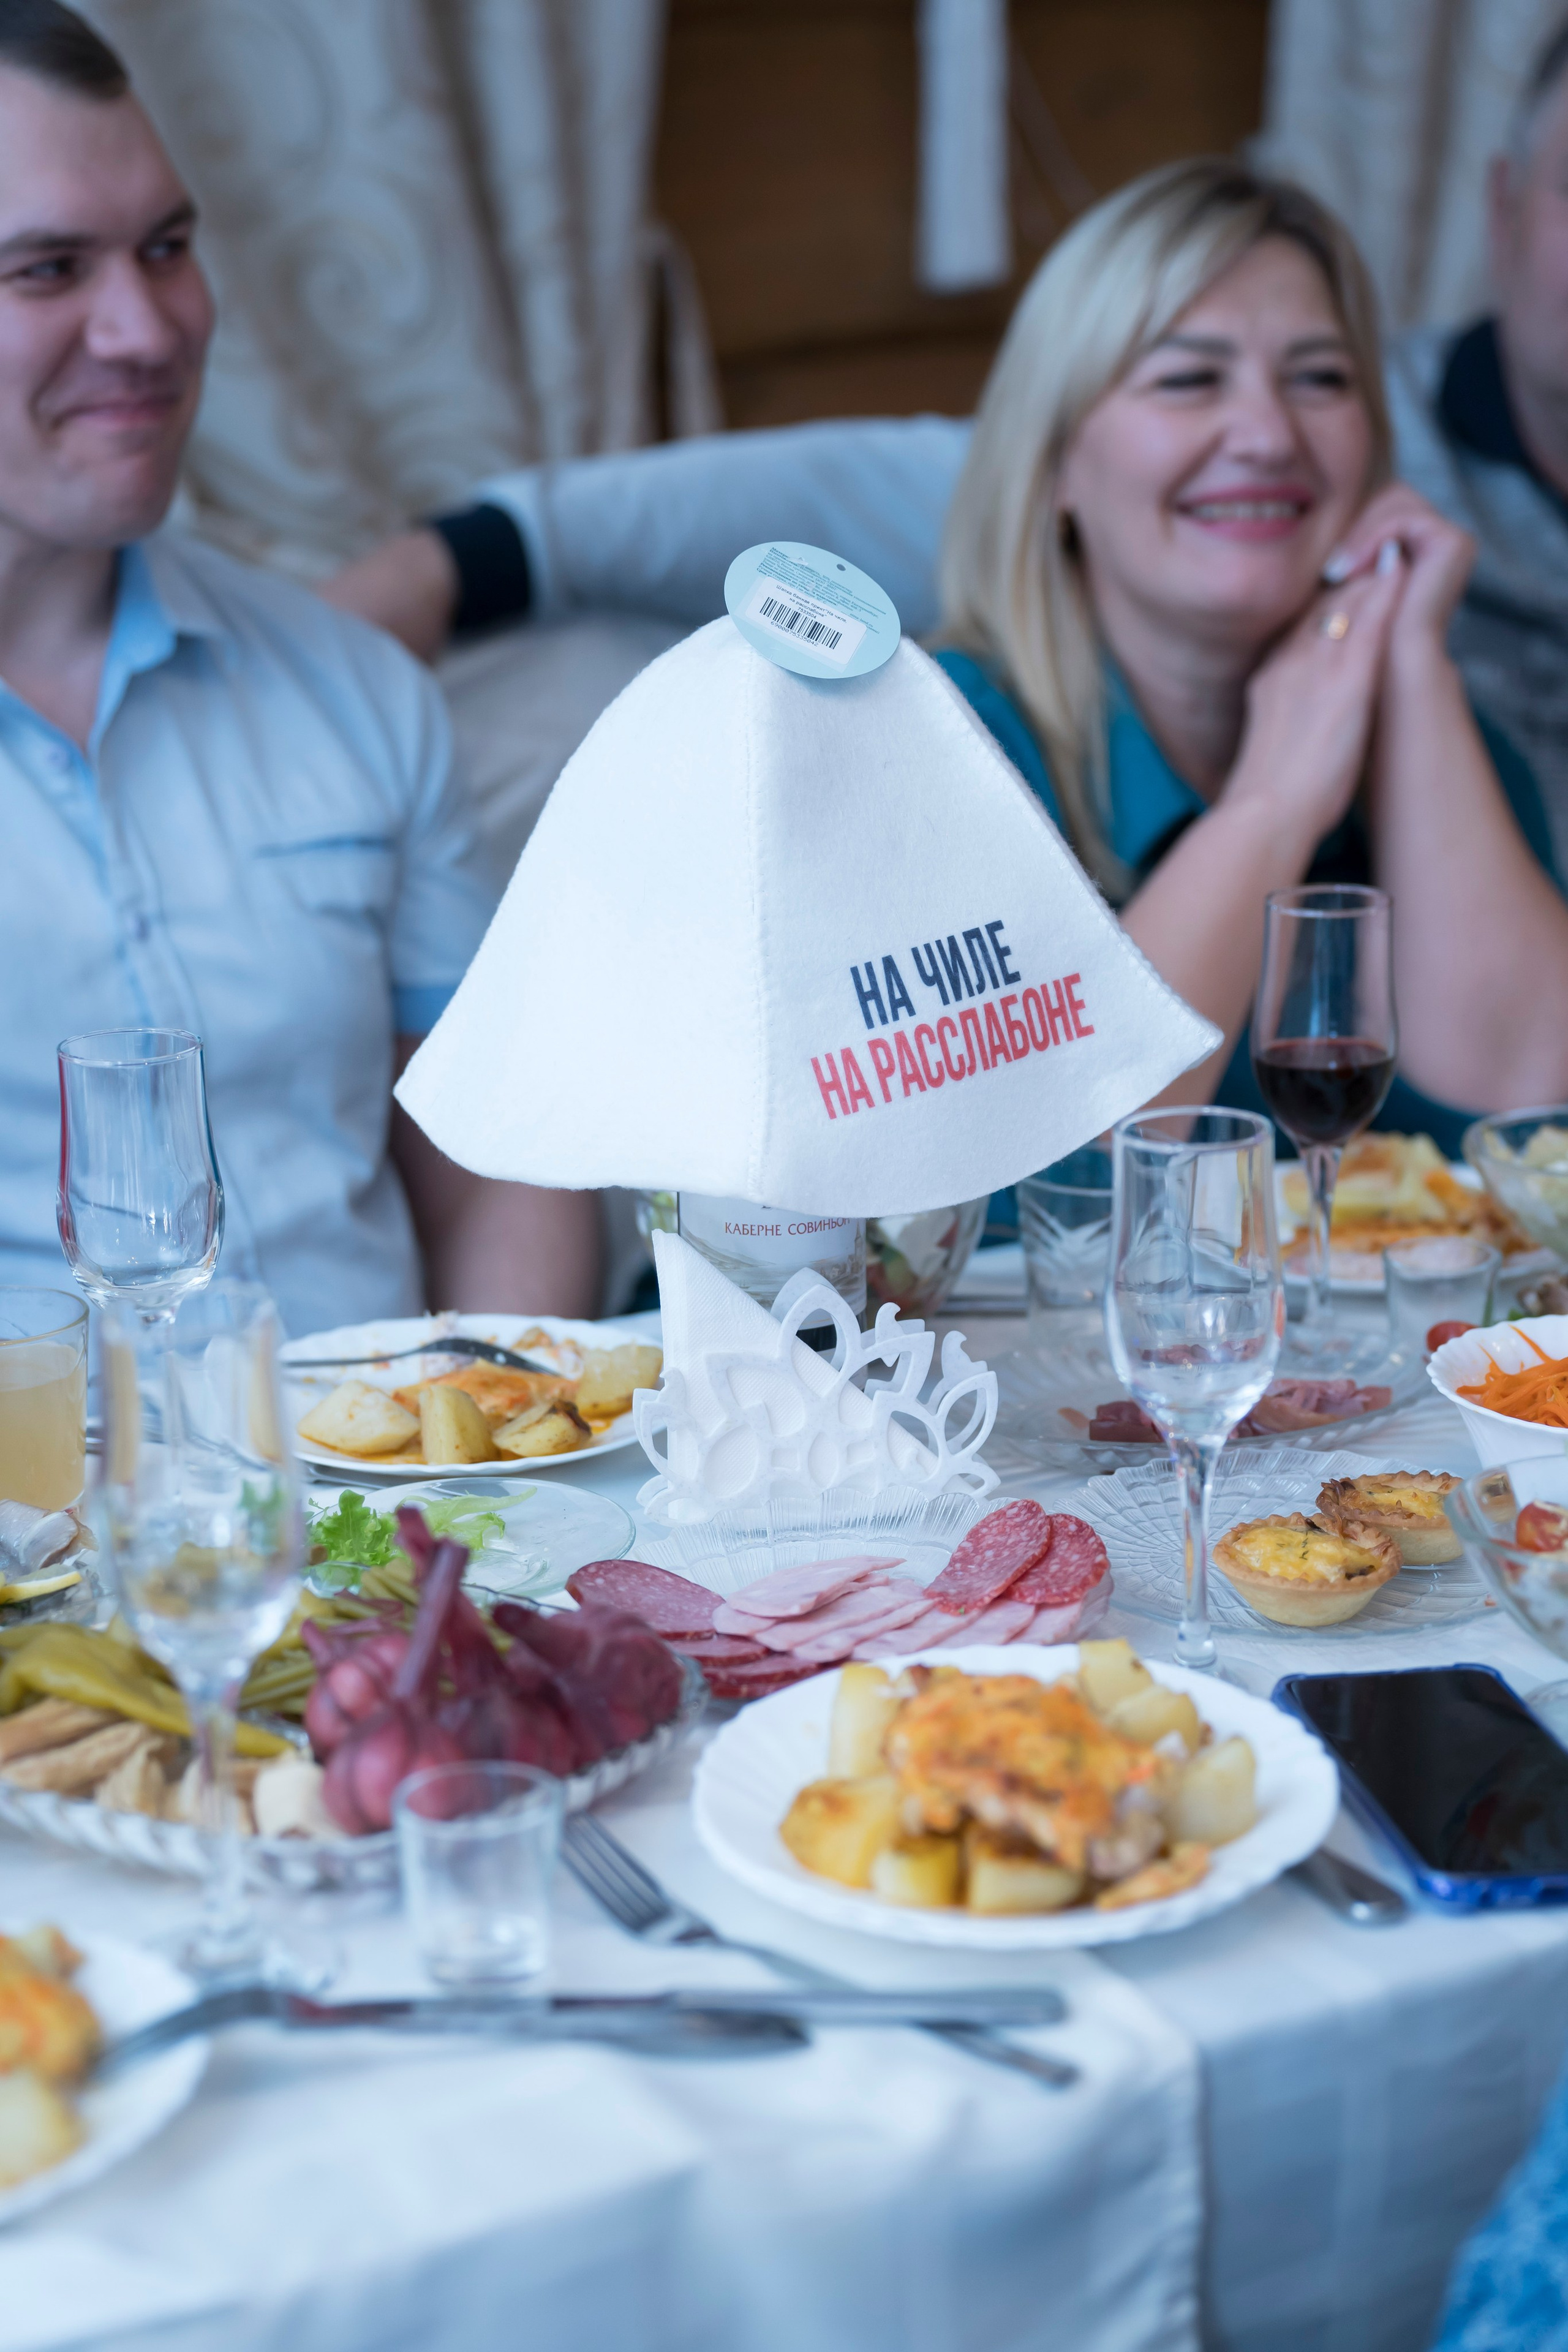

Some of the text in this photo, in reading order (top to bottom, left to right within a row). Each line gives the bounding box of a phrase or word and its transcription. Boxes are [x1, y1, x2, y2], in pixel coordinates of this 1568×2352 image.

[776, 584, 792, 595] Шапка
[793, 593, 810, 605] банная
[797, 607, 816, 619] 7533504
[771, 621, 819, 647] 6900075335042
[850, 920, 1022, 1030] НА ЧИЛЕ
[811, 973, 1095, 1120] НА РАССЛАБОНЕ
[725, 1222, 782, 1236] КАБЕРНЕ
